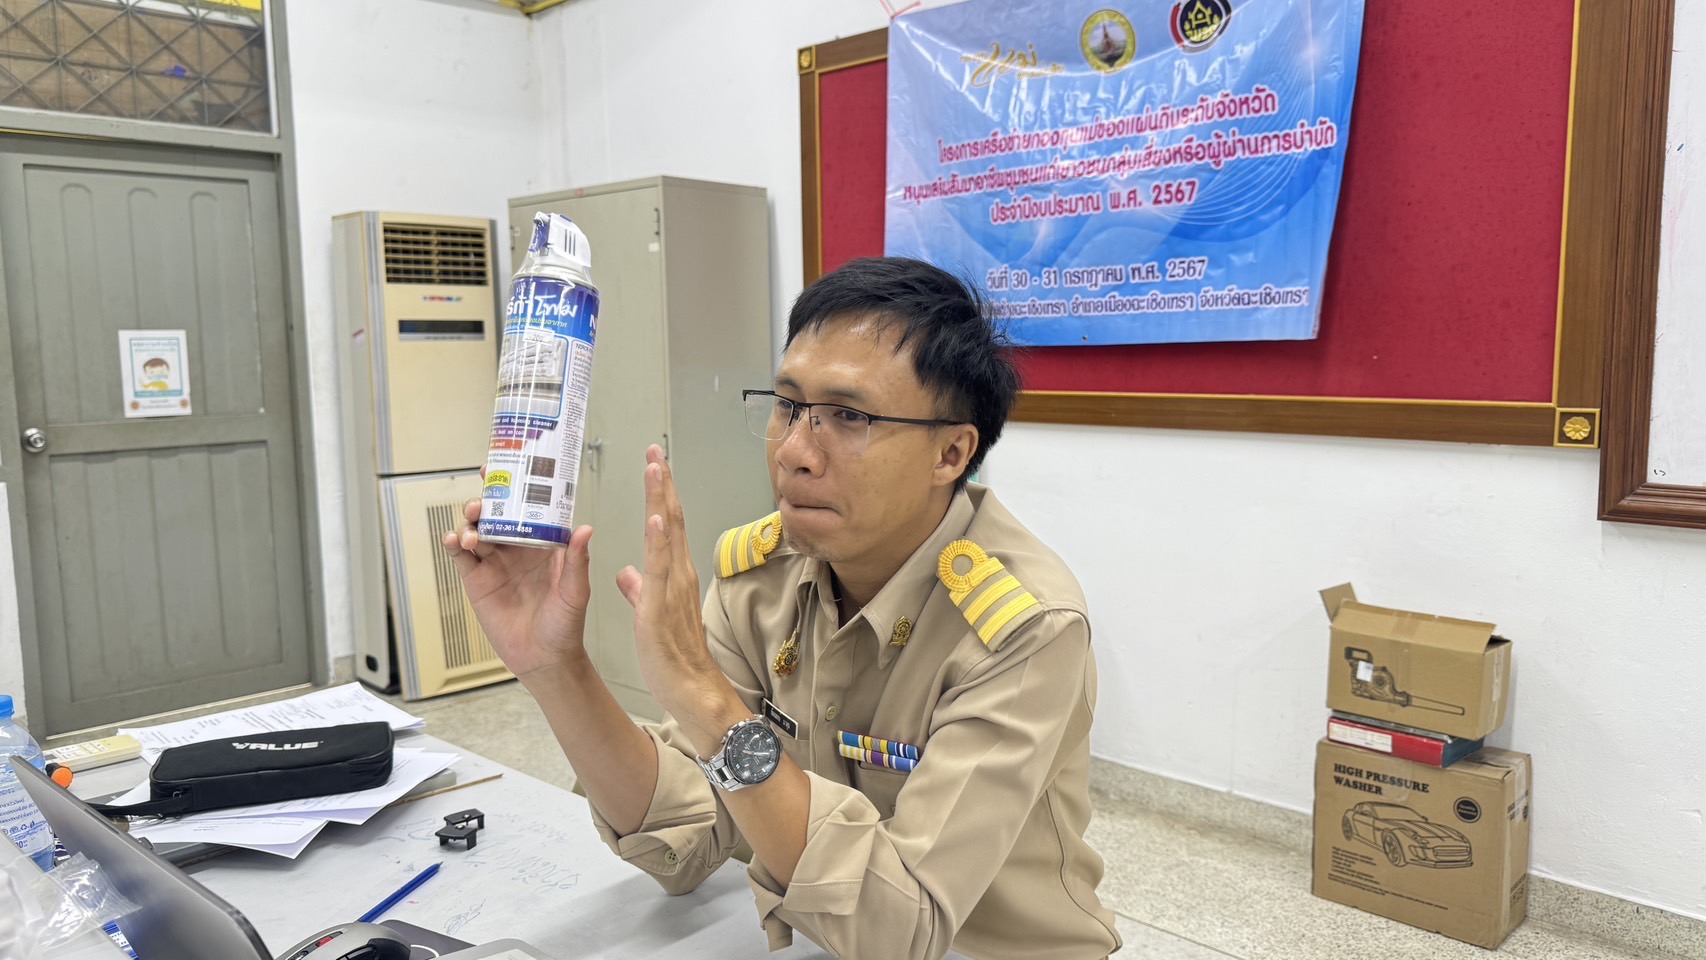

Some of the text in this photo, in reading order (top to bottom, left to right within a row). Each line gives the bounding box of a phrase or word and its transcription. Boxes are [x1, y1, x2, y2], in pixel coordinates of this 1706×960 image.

[991, 181, 1197, 223] ประจำปีงบประมาณ พ.ศ. 2567
[988, 265, 1009, 289] วันที่
[1013, 271, 1028, 288] 30
[1043, 269, 1058, 287] 31
[1063, 266, 1123, 290] กรกฎาคม
[1131, 264, 1160, 281] พ.ศ.
[1167, 259, 1206, 280] 2567
[1072, 292, 1194, 315] อำเภอเมืองฉะเชิงเทรา
[1200, 286, 1309, 309] จังหวัดฉะเชิงเทรา
[232, 741, 319, 751] VALUE
[1333, 775, 1383, 795] WASHER
[1334, 763, 1429, 793] HIGH PRESSURE
